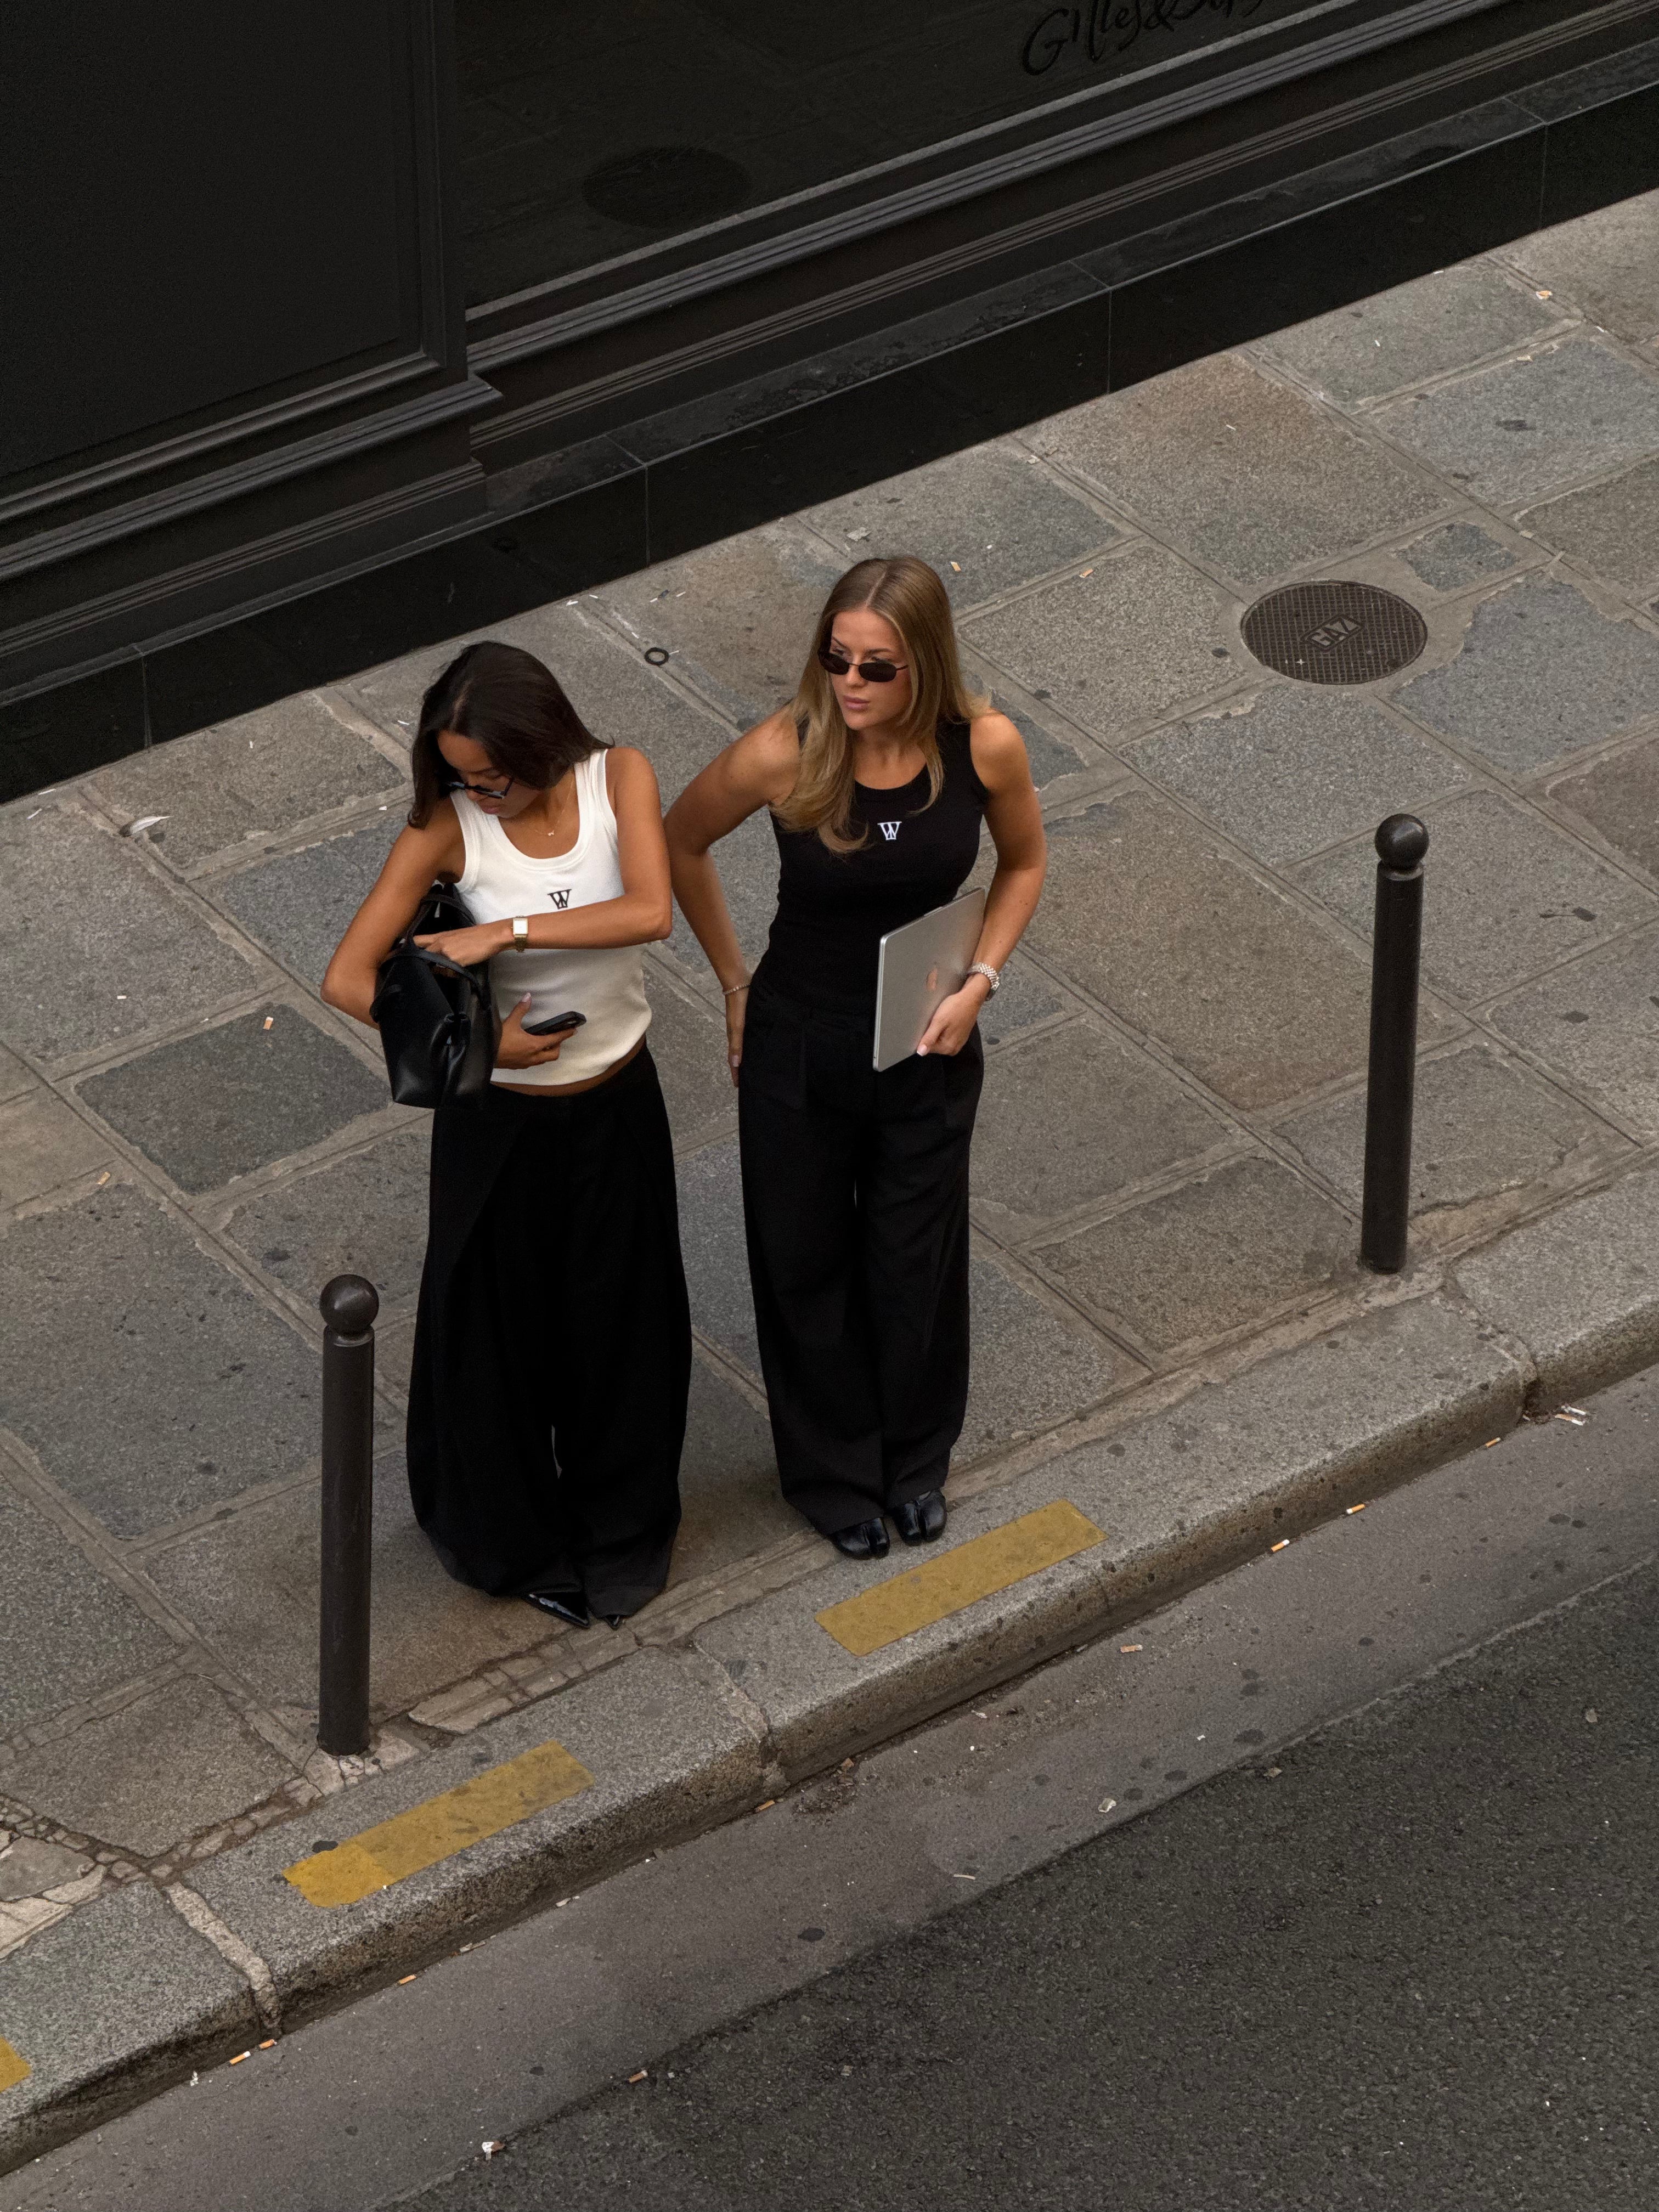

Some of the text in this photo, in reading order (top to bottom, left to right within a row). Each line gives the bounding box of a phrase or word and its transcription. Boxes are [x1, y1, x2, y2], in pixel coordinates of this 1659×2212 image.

[1306, 616, 1359, 646] GAZ
[877, 821, 902, 840] W
[548, 889, 572, 910] W
